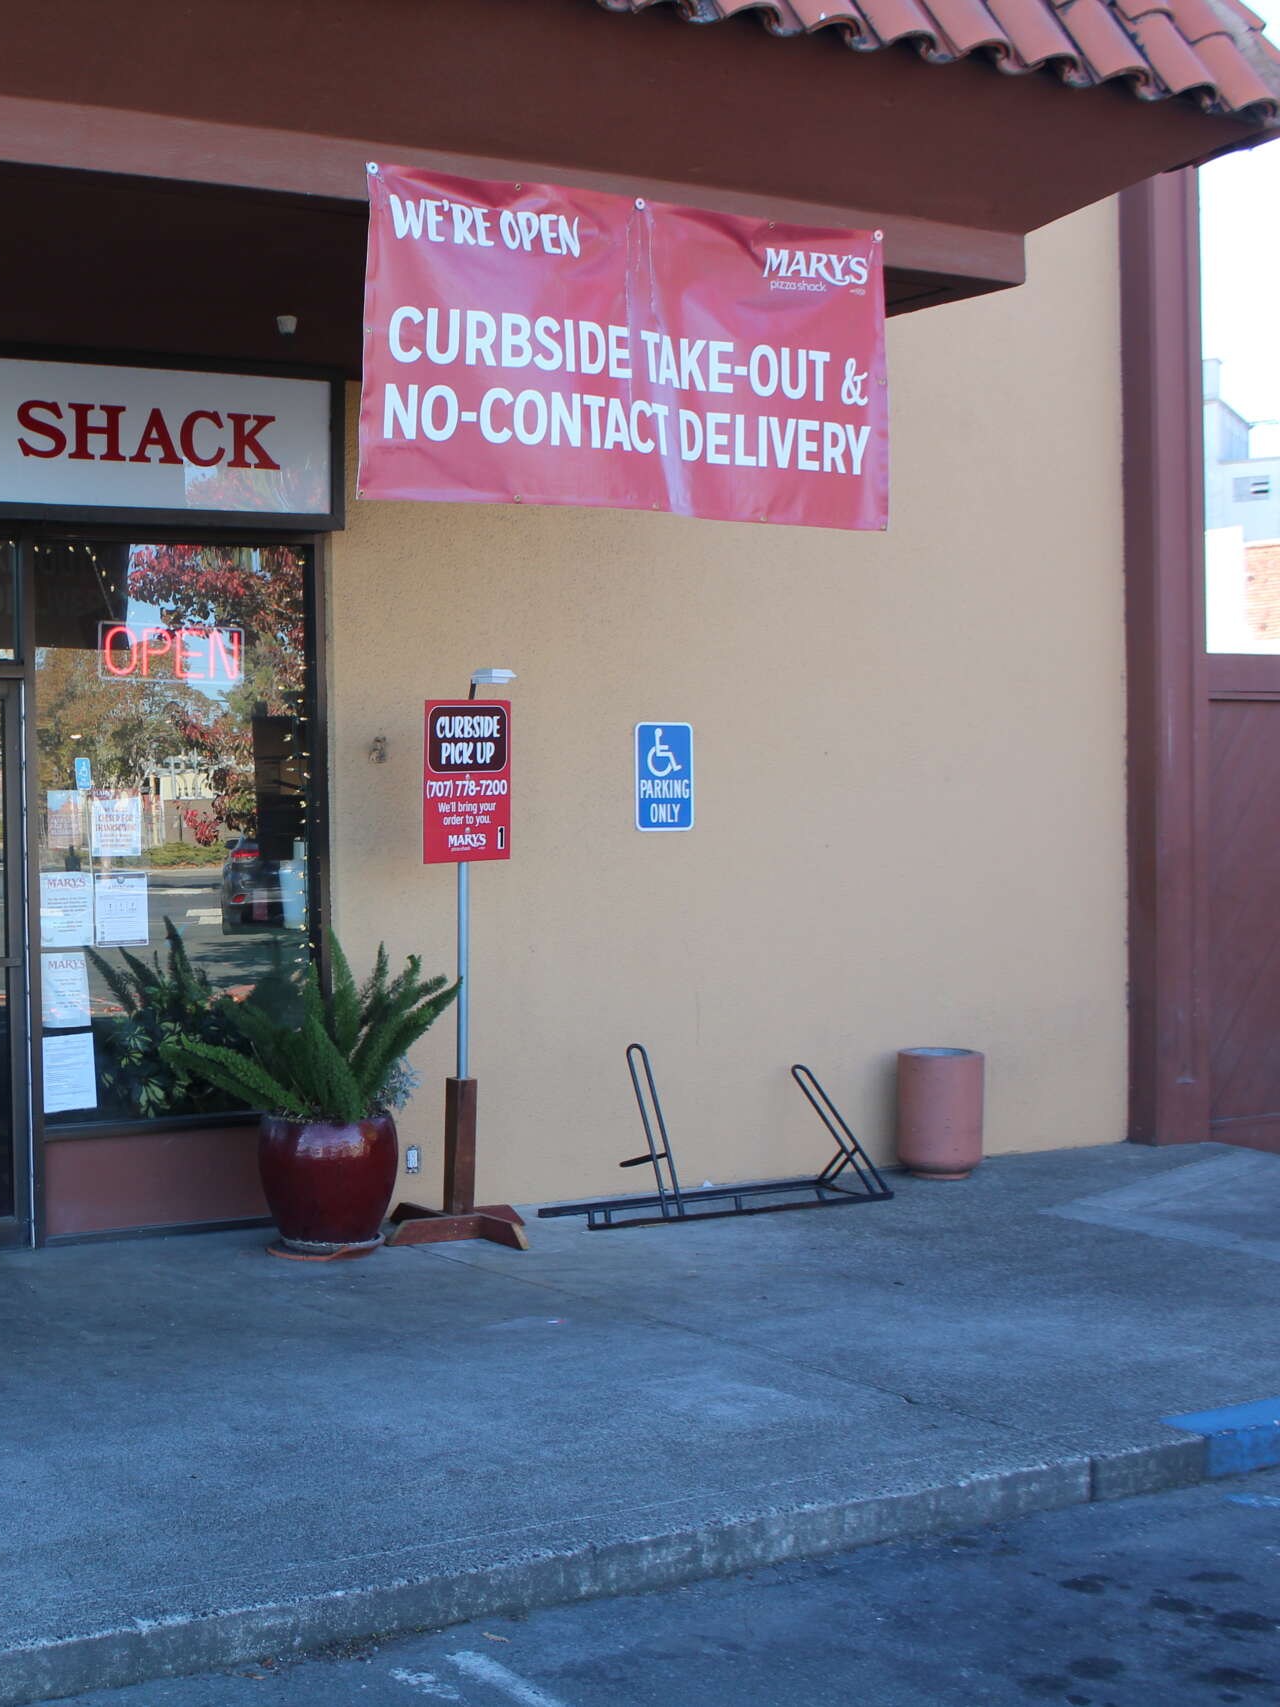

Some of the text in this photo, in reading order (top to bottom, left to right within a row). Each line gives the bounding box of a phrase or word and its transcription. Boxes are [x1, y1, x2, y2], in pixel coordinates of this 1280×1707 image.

[389, 194, 581, 257] WE'RE OPEN
[762, 248, 868, 286] MARY'S
[770, 280, 797, 291] pizza
[388, 305, 869, 406] CURBSIDE TAKE-OUT &
[16, 400, 281, 471] SHACK
[384, 383, 871, 475] NO-CONTACT DELIVERY
[104, 625, 241, 680] OPEN
[435, 716, 501, 739] CURBSIDE
[440, 742, 496, 765] PICK UP
[426, 780, 508, 798] (707) 778-7200
[640, 779, 690, 799] PARKING
[438, 801, 496, 814] We'll bring your
[650, 803, 681, 823] ONLY
[443, 814, 491, 826] order to you.
[499, 827, 504, 848] 1
